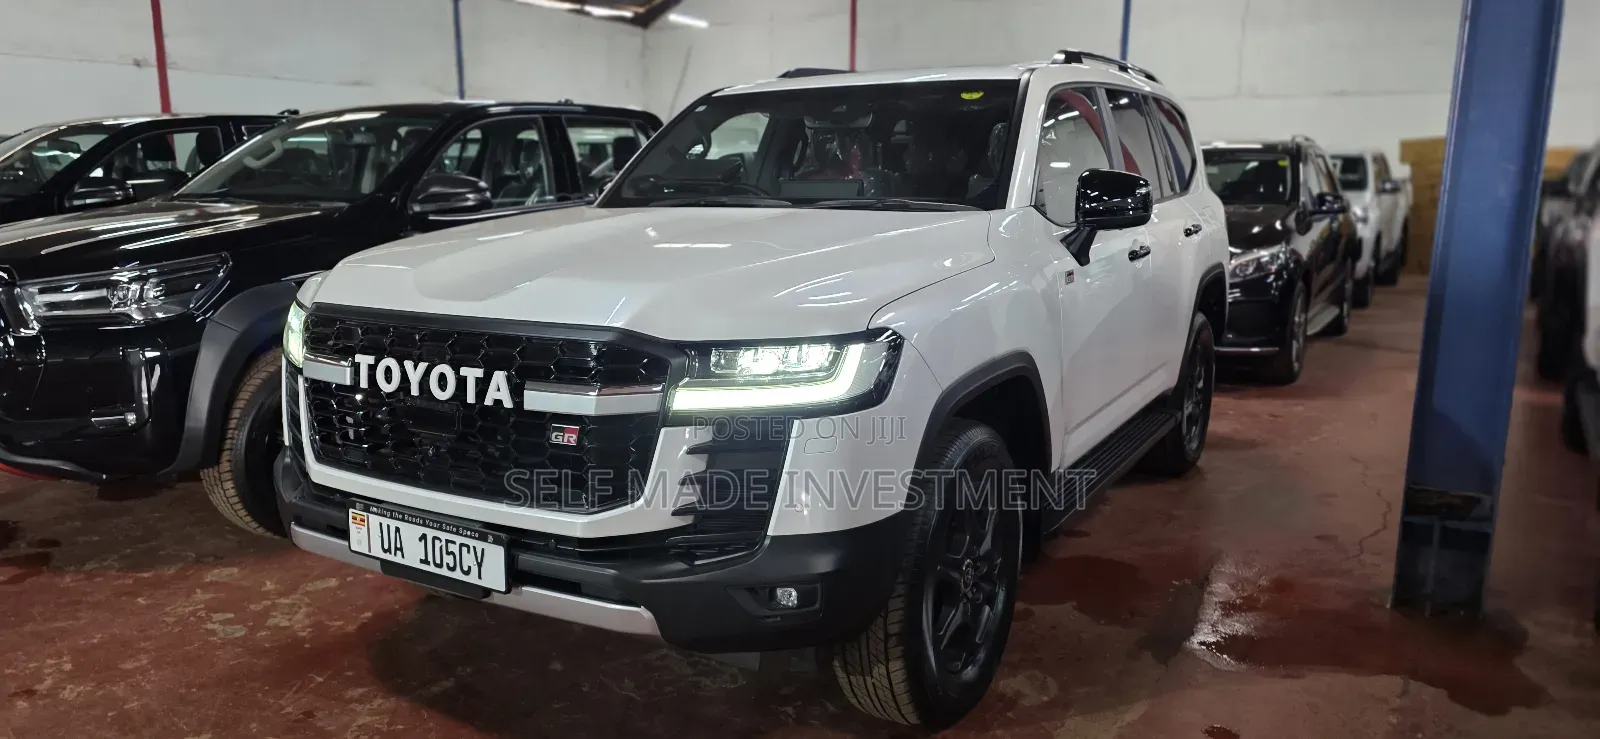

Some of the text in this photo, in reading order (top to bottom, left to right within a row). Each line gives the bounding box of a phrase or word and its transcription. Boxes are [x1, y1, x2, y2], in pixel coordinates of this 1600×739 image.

[354, 353, 514, 409] TOYOTA
[379, 521, 485, 580] UA 105CY
